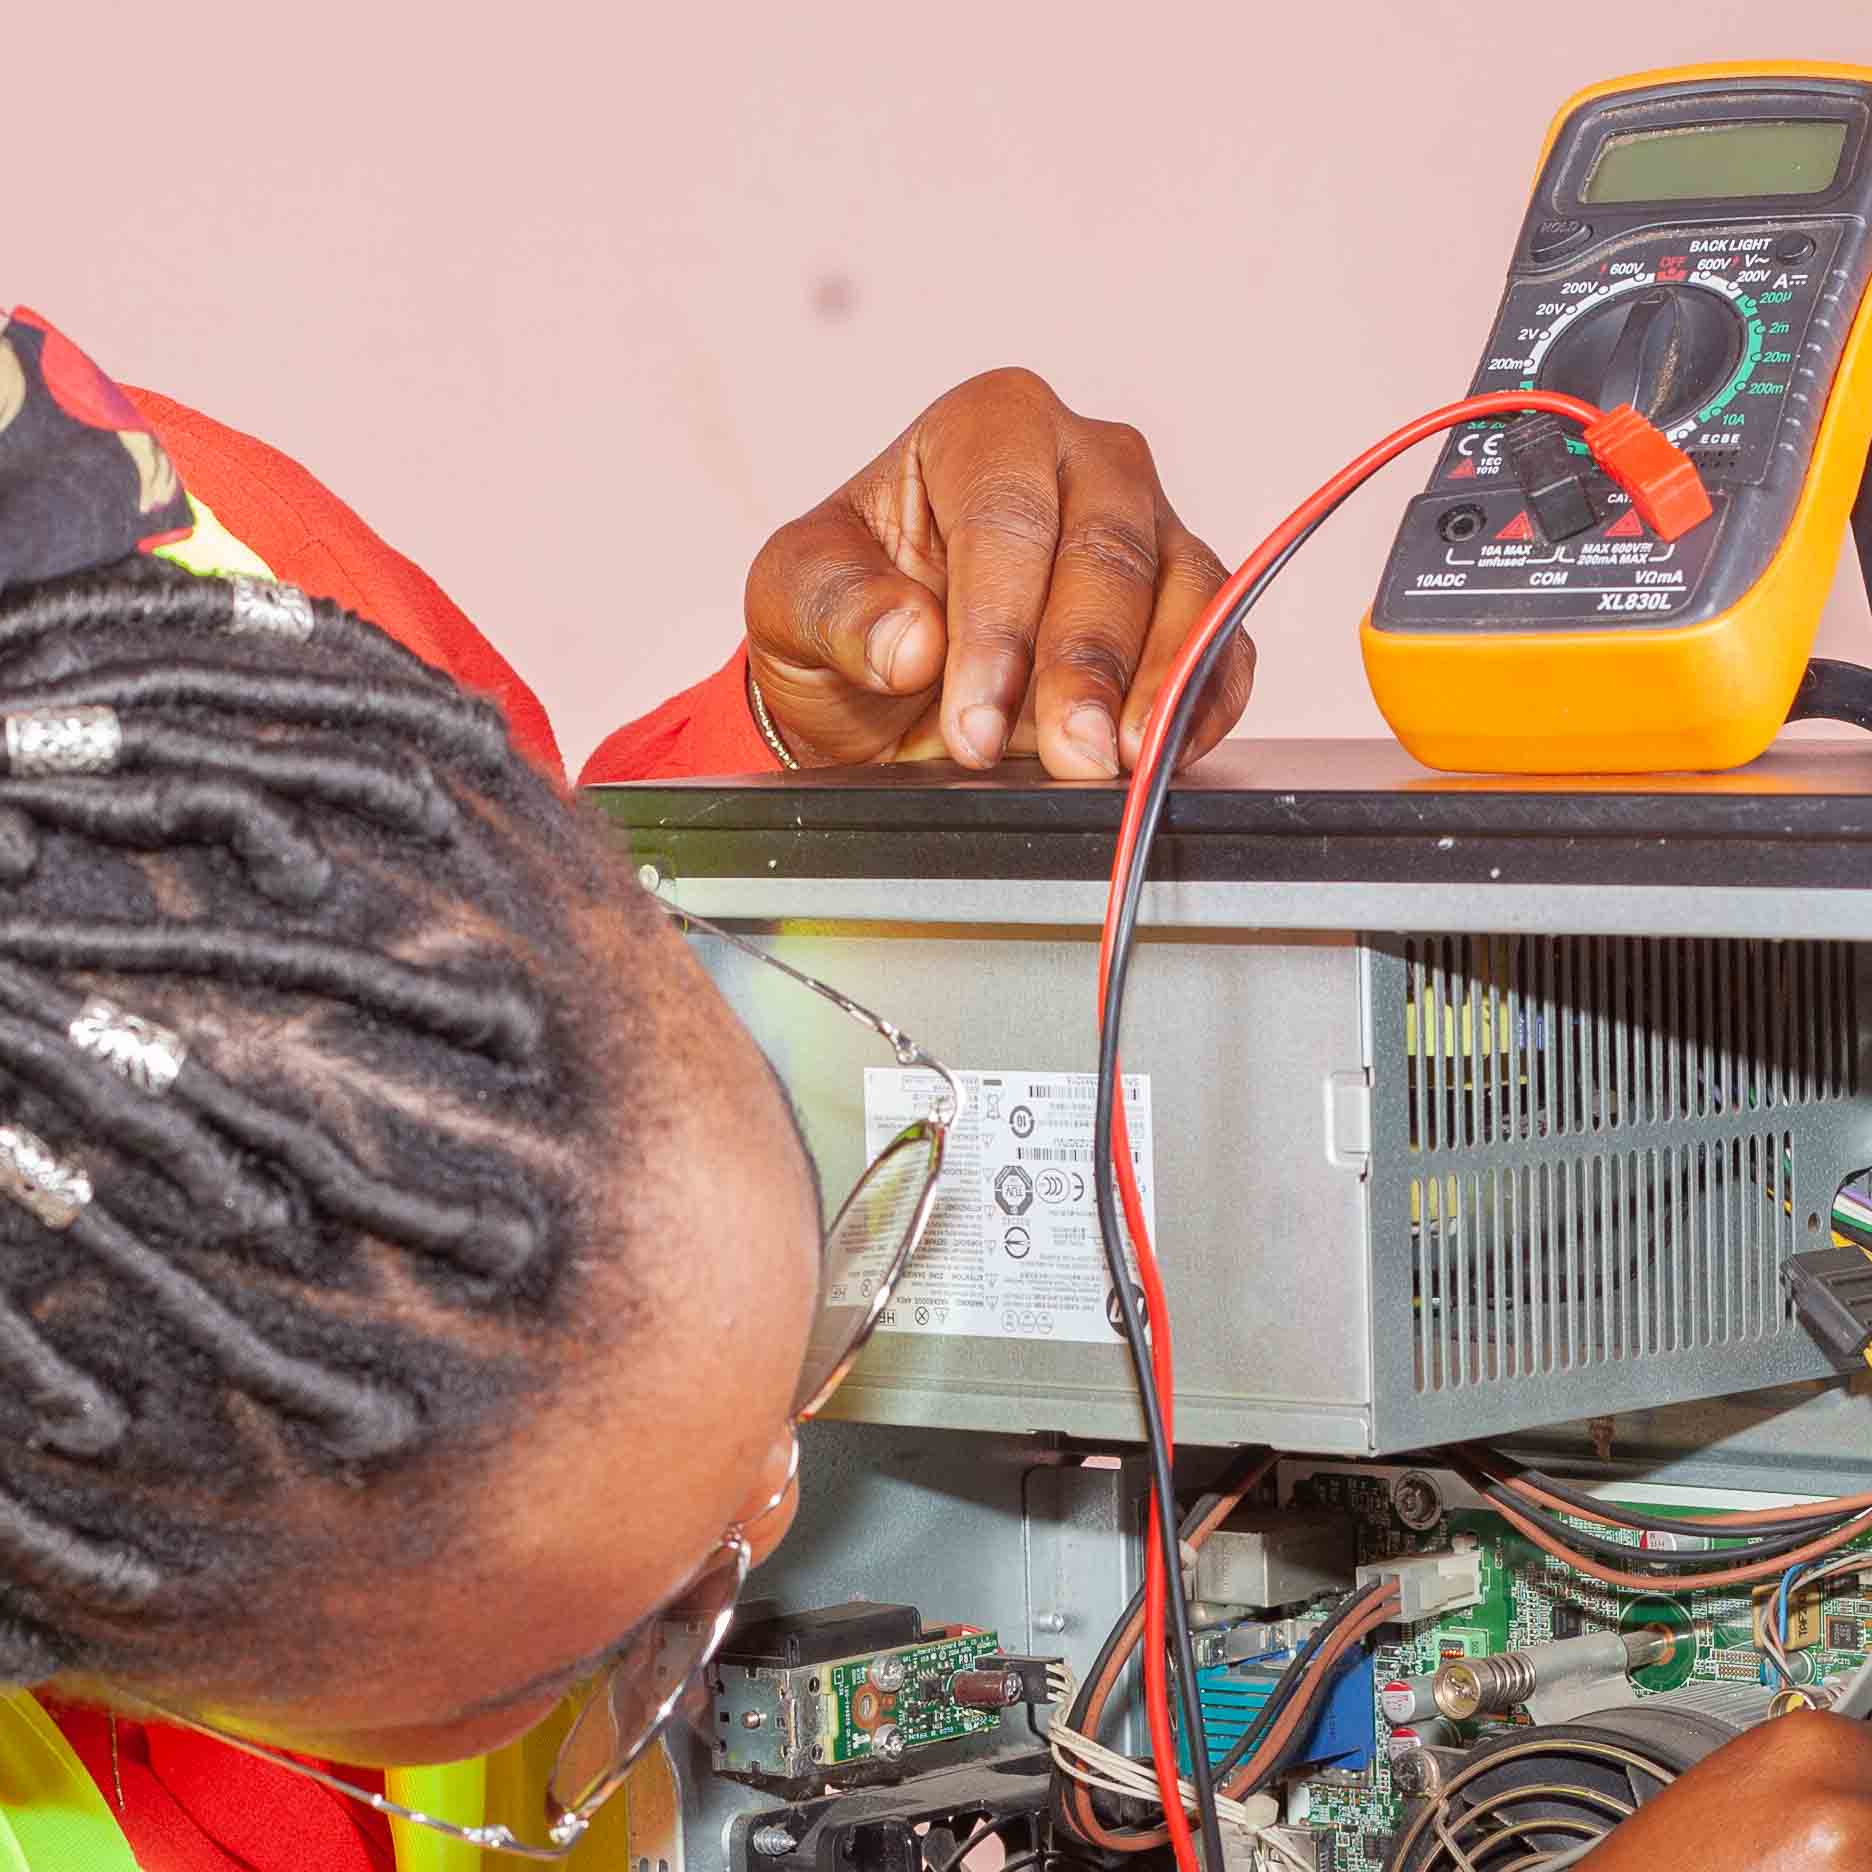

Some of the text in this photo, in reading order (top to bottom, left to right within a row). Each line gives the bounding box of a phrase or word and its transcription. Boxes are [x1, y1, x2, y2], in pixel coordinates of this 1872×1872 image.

[1690, 239, 1772, 252] BACK LIGHT
[1610, 263, 1644, 275] 600V
[1697, 258, 1730, 270] 600V
[1737, 271, 1771, 282] 200V
[1561, 283, 1597, 295] 200V
[1536, 304, 1565, 315] 20V
[1518, 329, 1539, 340] 2V
[1769, 323, 1790, 334] 2m
[1763, 352, 1791, 363] 20m
[1488, 359, 1523, 370] 200m
[1748, 383, 1784, 395] 200m
[1722, 413, 1745, 426] 10A
[1480, 544, 1532, 556] 10A MAX
[1581, 544, 1610, 554] MAX
[1478, 557, 1526, 568] unfused
[1619, 553, 1649, 565] MAX
[1416, 573, 1467, 588] 10ADC
[1530, 571, 1569, 586] COM
[1597, 593, 1672, 611] XL830L
